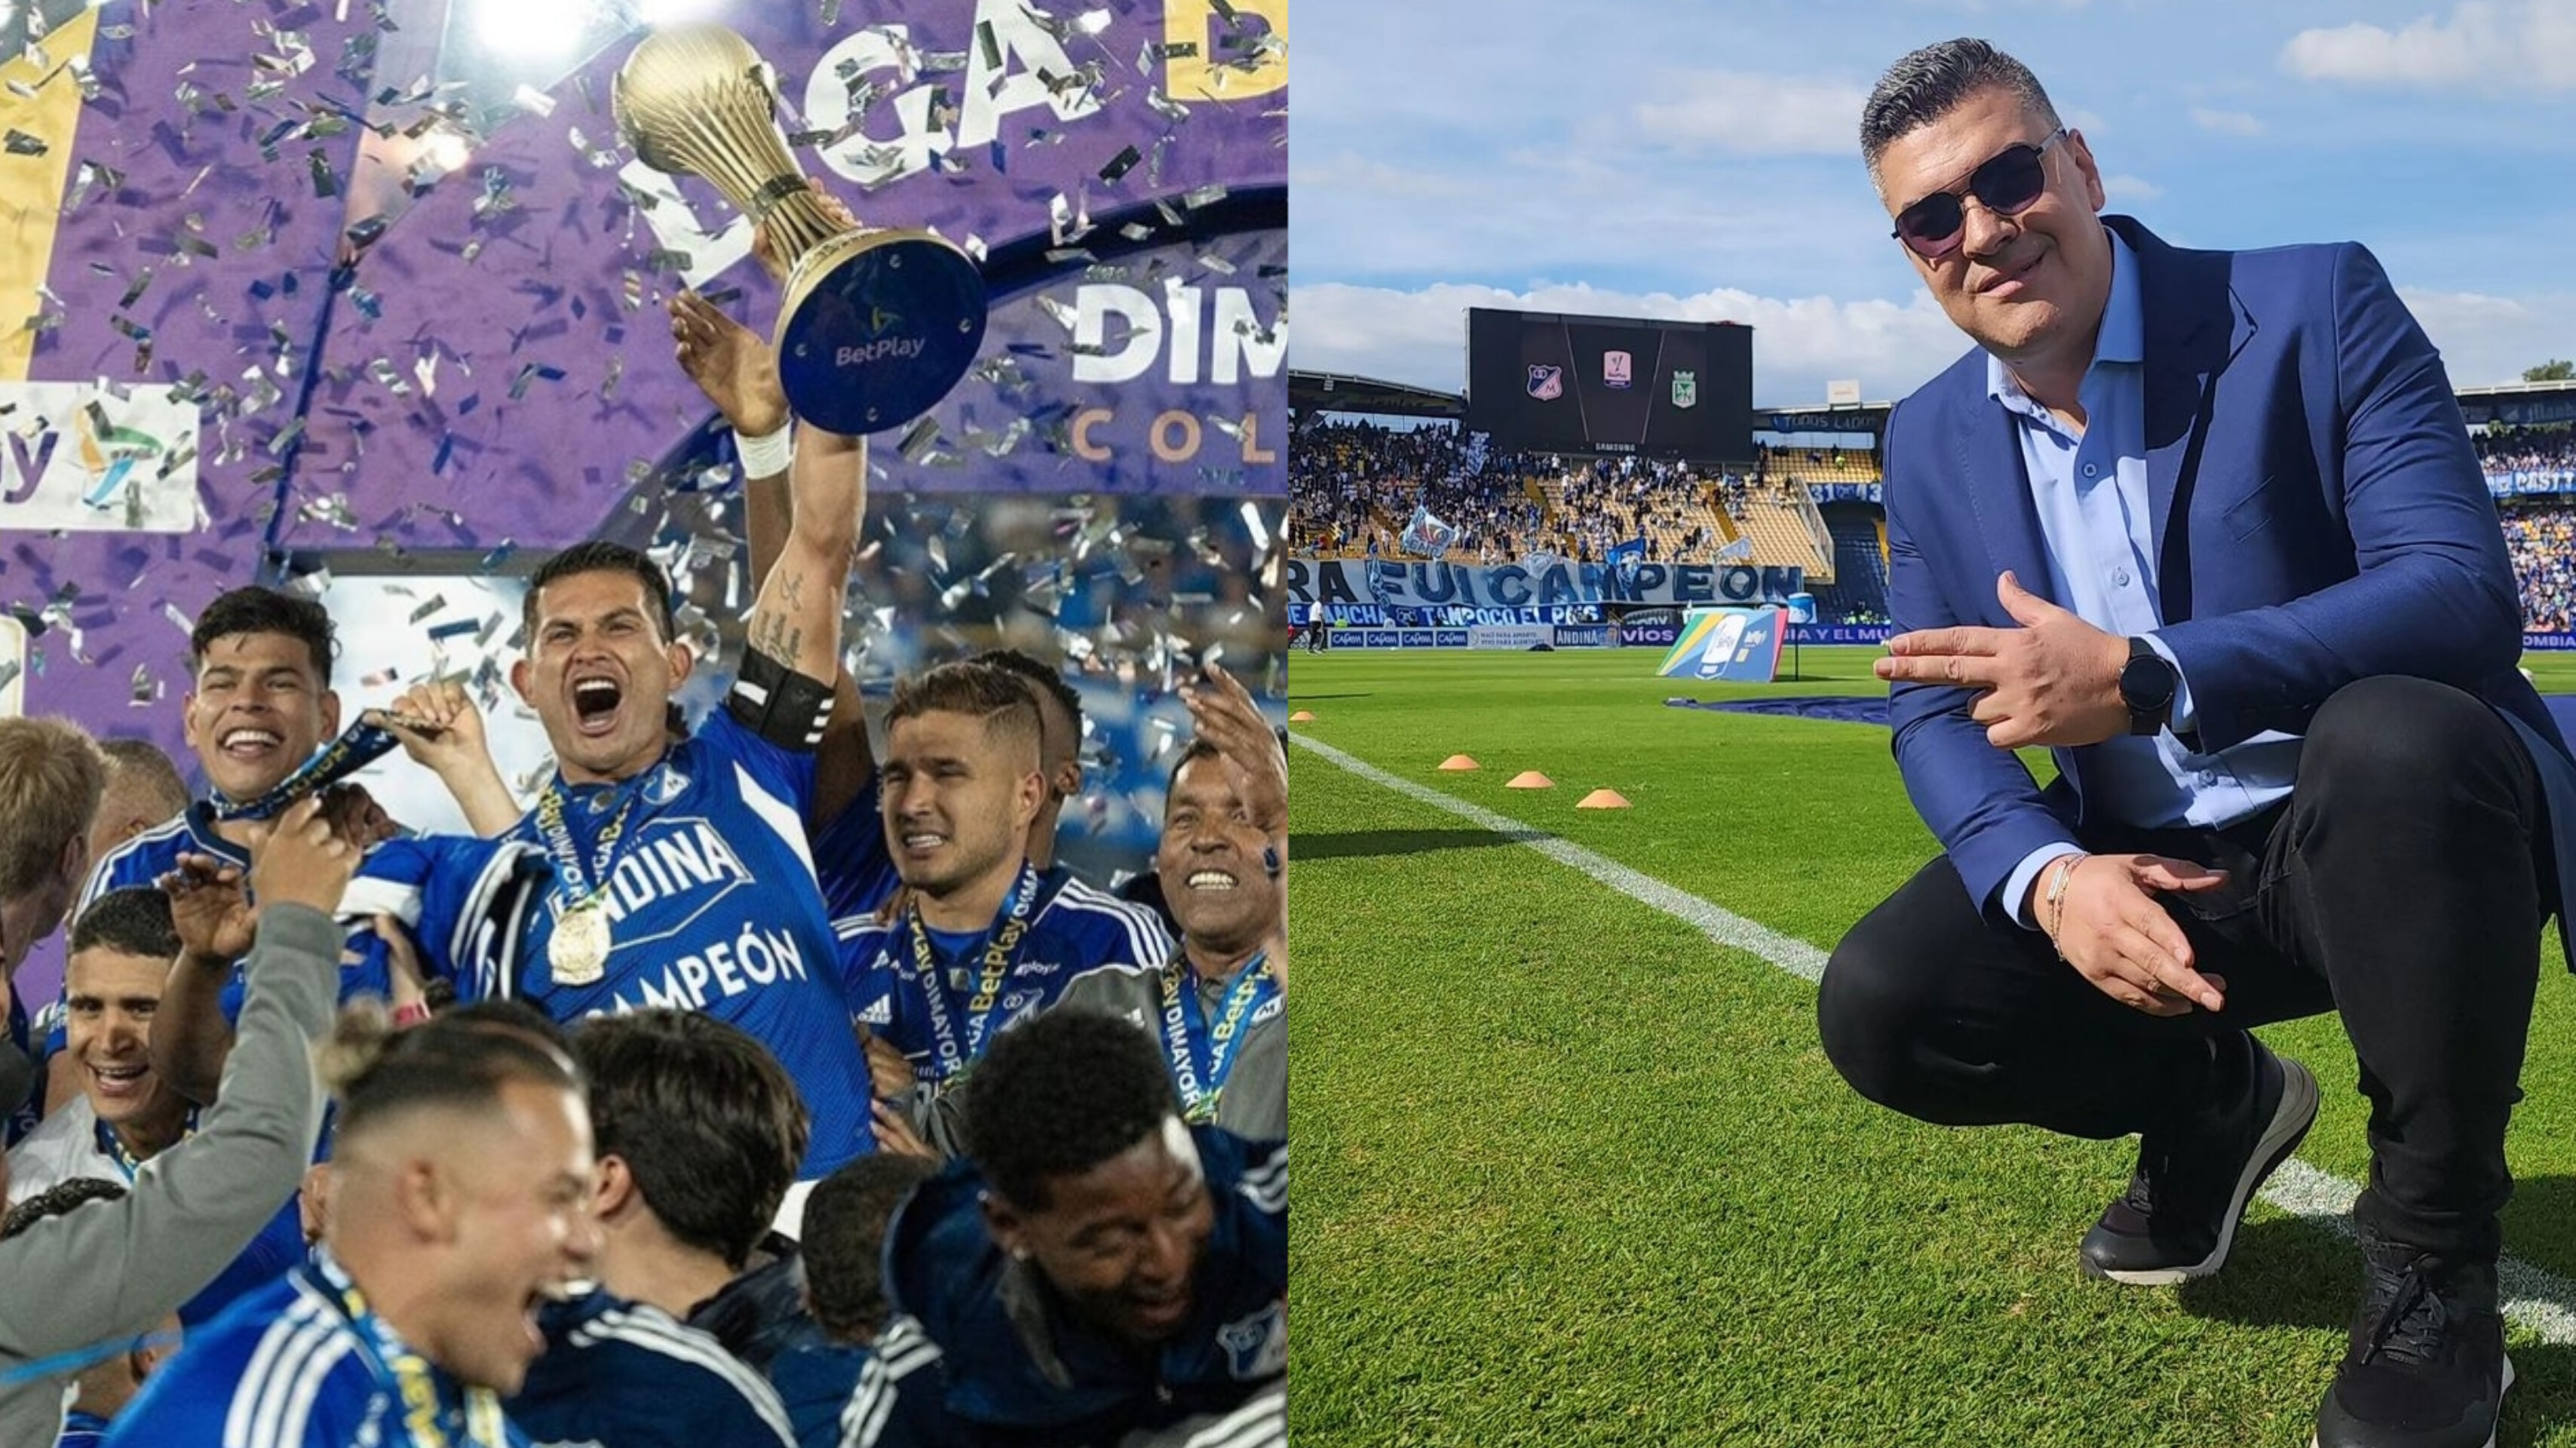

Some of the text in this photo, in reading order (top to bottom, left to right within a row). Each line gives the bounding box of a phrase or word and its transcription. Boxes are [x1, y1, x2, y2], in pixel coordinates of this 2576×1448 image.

[618, 0, 1102, 289] LGA
[836, 336, 926, 367] BetPlay
[1072, 409, 1275, 462] COL
[1556, 629, 1598, 645] ANDINA
[585, 922, 807, 1017] MPEÓN
[922, 971, 962, 1075] DIMAYOR
[1166, 1005, 1201, 1108] DIMAYOR
